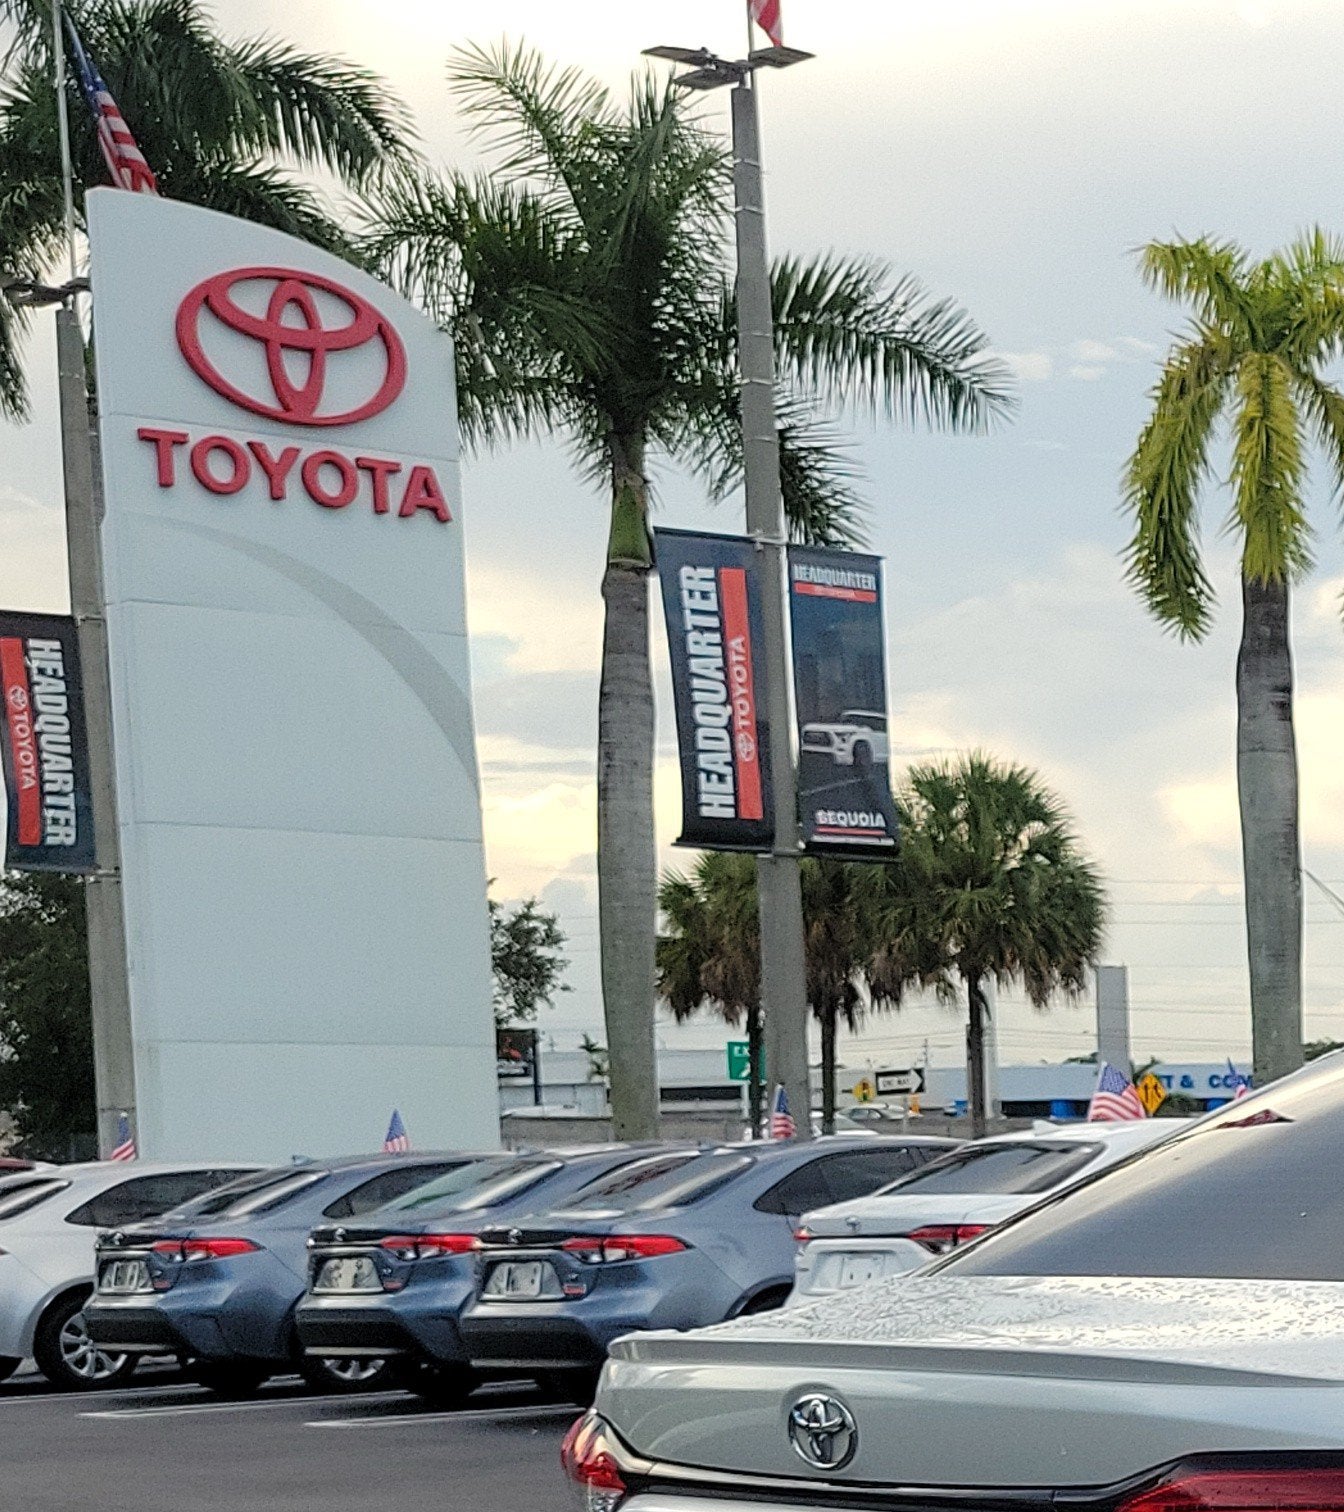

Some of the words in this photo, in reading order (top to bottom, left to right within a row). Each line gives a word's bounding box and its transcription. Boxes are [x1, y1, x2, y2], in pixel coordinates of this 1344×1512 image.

[137, 427, 453, 523] TOYOTA
[793, 564, 877, 591] HEADQUARTER
[680, 565, 736, 819] HEADQUARTER
[728, 636, 750, 730] TOYOTA
[15, 710, 37, 790] TOYOTA
[27, 638, 77, 846] HEADQUARTER
[815, 809, 886, 828] SEQUOIA
